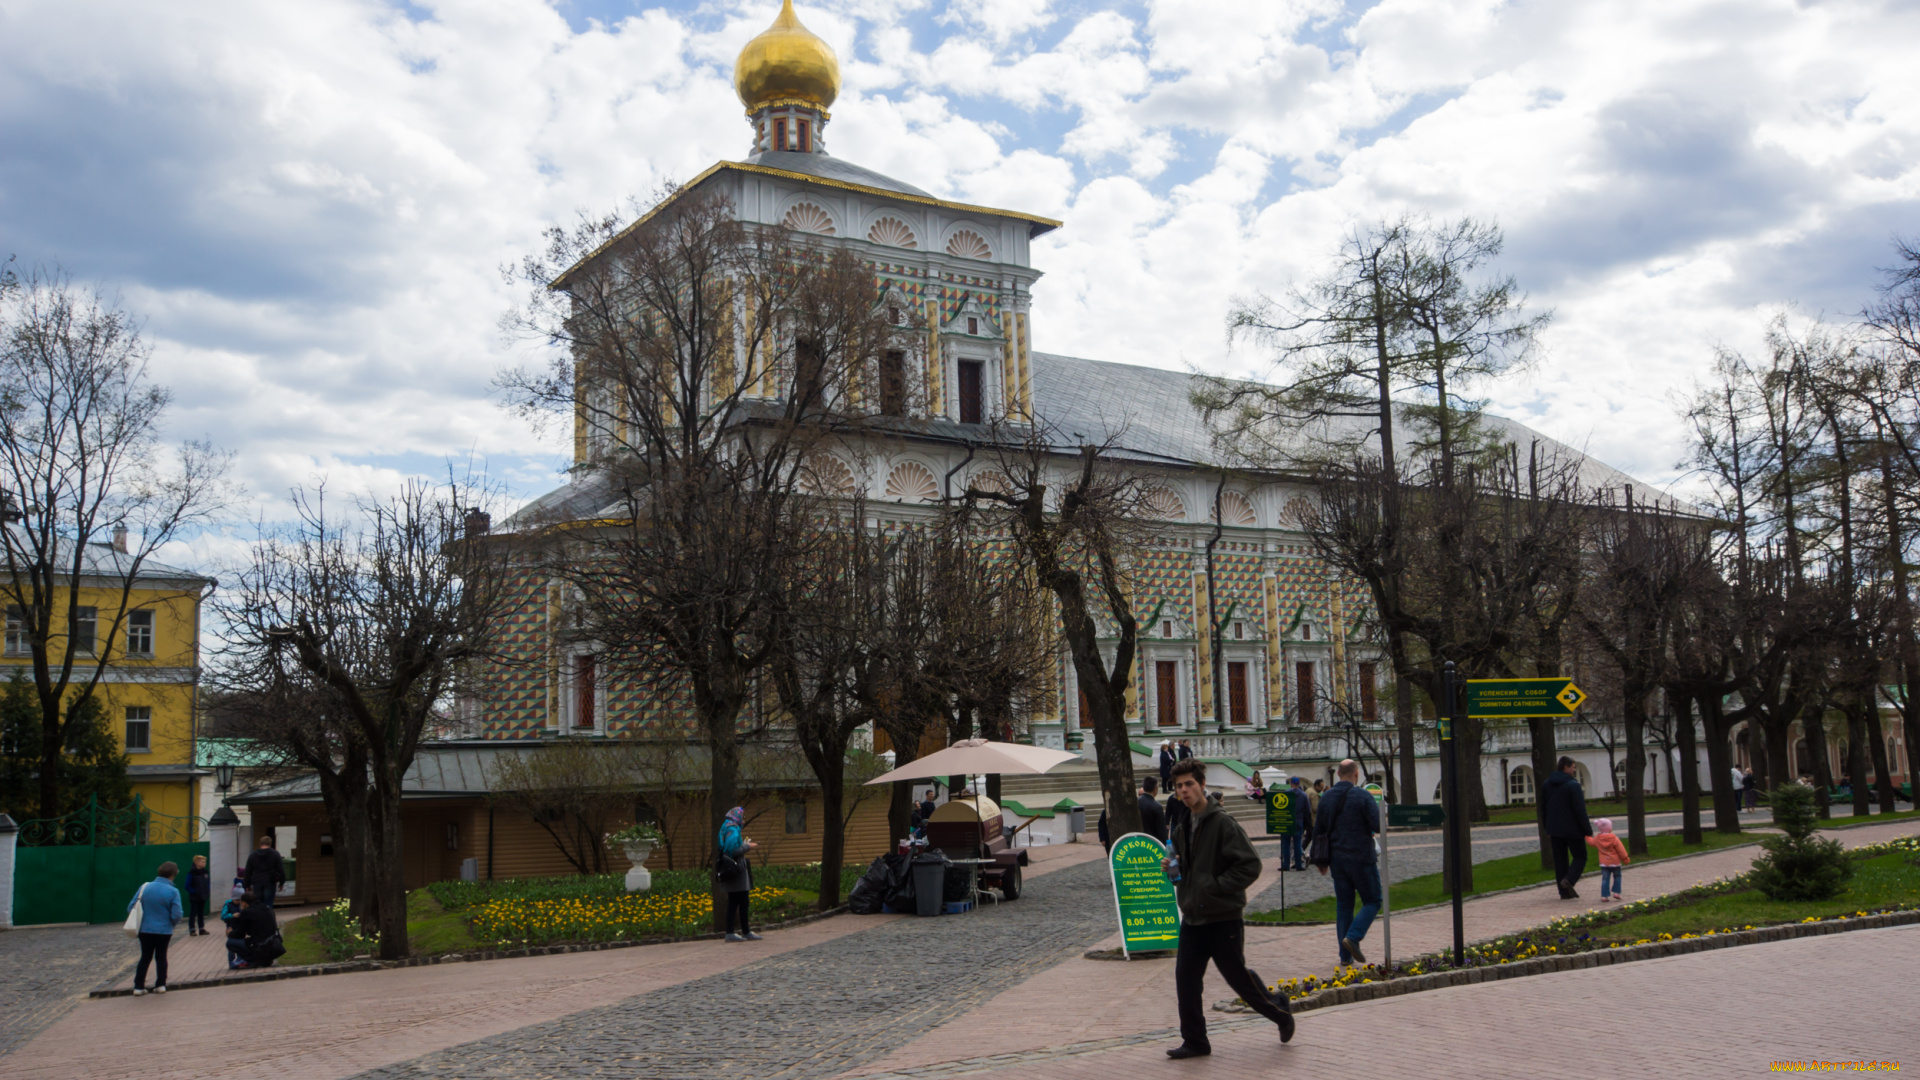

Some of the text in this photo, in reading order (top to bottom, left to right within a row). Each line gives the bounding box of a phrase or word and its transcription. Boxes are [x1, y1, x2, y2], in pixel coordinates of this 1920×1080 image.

[1116, 841, 1163, 862] ЦЕРКОВНАЯ
[1127, 856, 1154, 864] ЛАВКА
[1126, 918, 1145, 926] 8.00
[1152, 916, 1175, 925] 18.00
